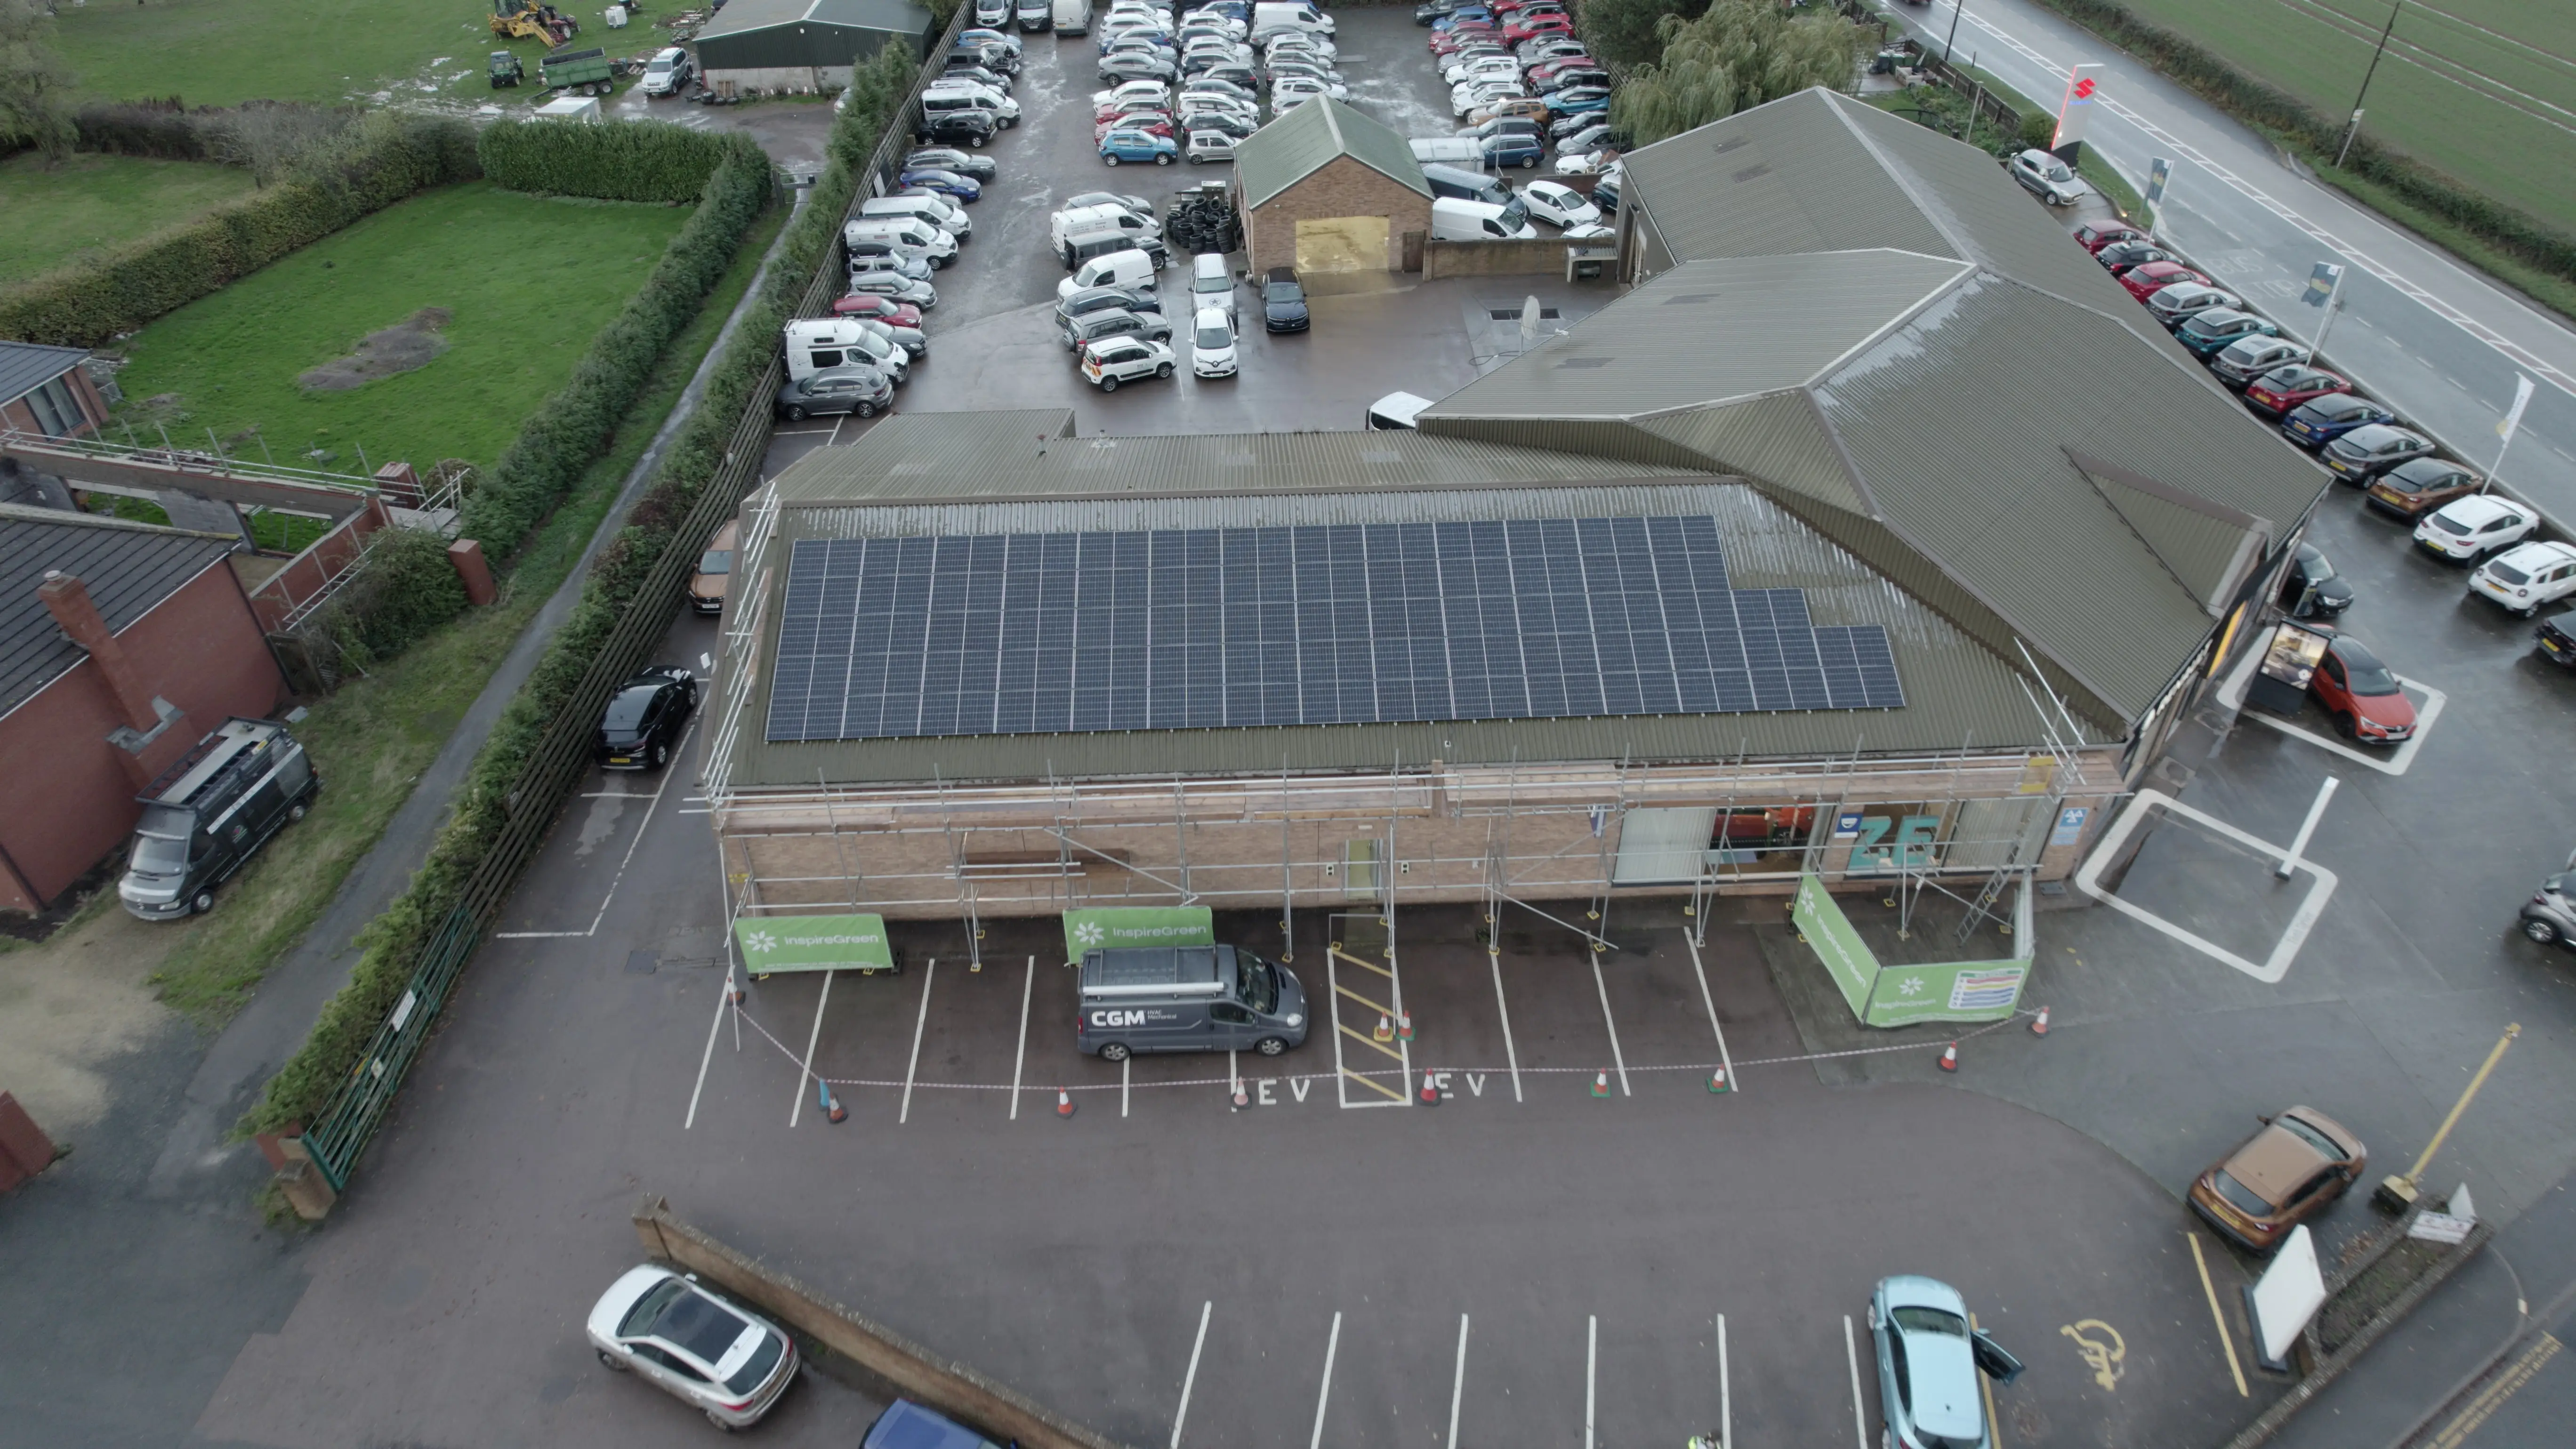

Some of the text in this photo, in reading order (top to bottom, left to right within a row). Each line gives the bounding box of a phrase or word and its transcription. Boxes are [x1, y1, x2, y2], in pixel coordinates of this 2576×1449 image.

[2205, 256, 2263, 274] BUS
[1113, 926, 1207, 939] InspireGreen
[784, 934, 879, 947] InspireGreen
[1092, 1010, 1146, 1026] CGM
